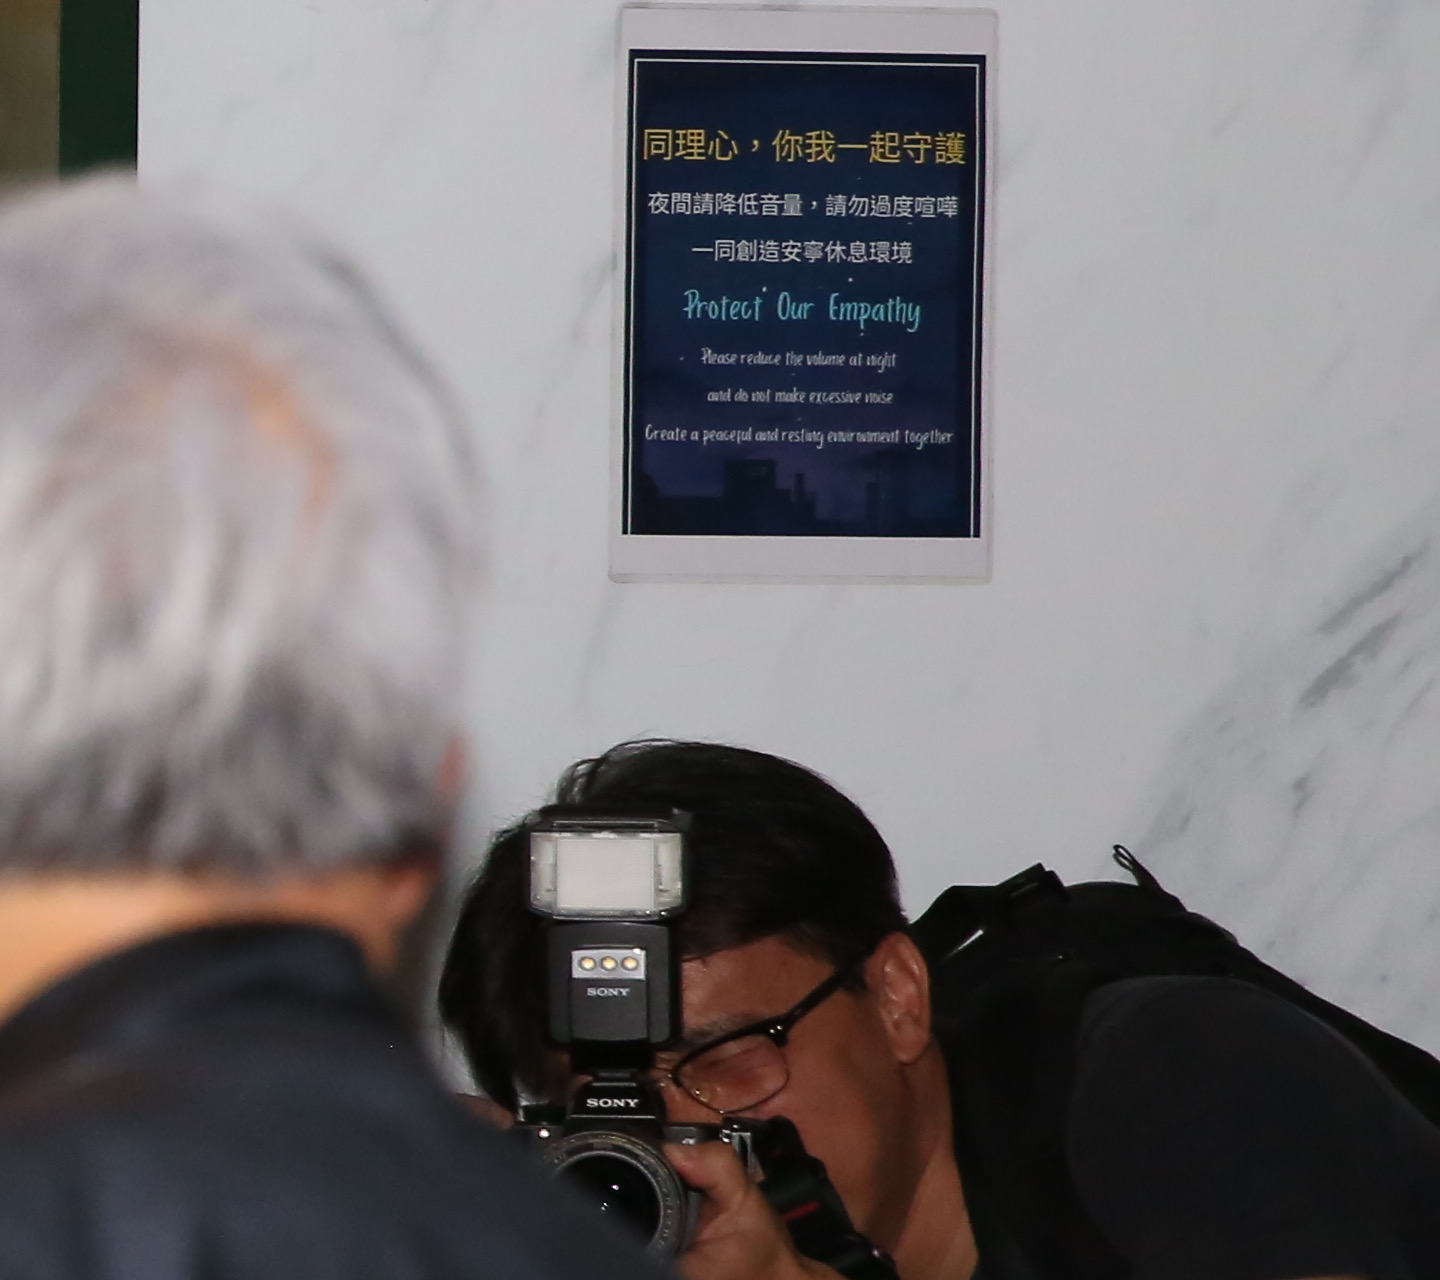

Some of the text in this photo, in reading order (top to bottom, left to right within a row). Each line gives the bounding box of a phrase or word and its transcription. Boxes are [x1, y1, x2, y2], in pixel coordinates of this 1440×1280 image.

[642, 129, 967, 165] 同理心，你我一起守護
[691, 239, 914, 264] 一同創造安寧休息環境
[683, 289, 921, 333] Protect Our Empathy
[700, 347, 897, 373] Please reduce the volume at night
[707, 387, 894, 405] and do not make excessive noise
[645, 424, 954, 450] Create a peaceful and resting environment together
[586, 987, 630, 997] SONY
[586, 1098, 639, 1108] SONY
